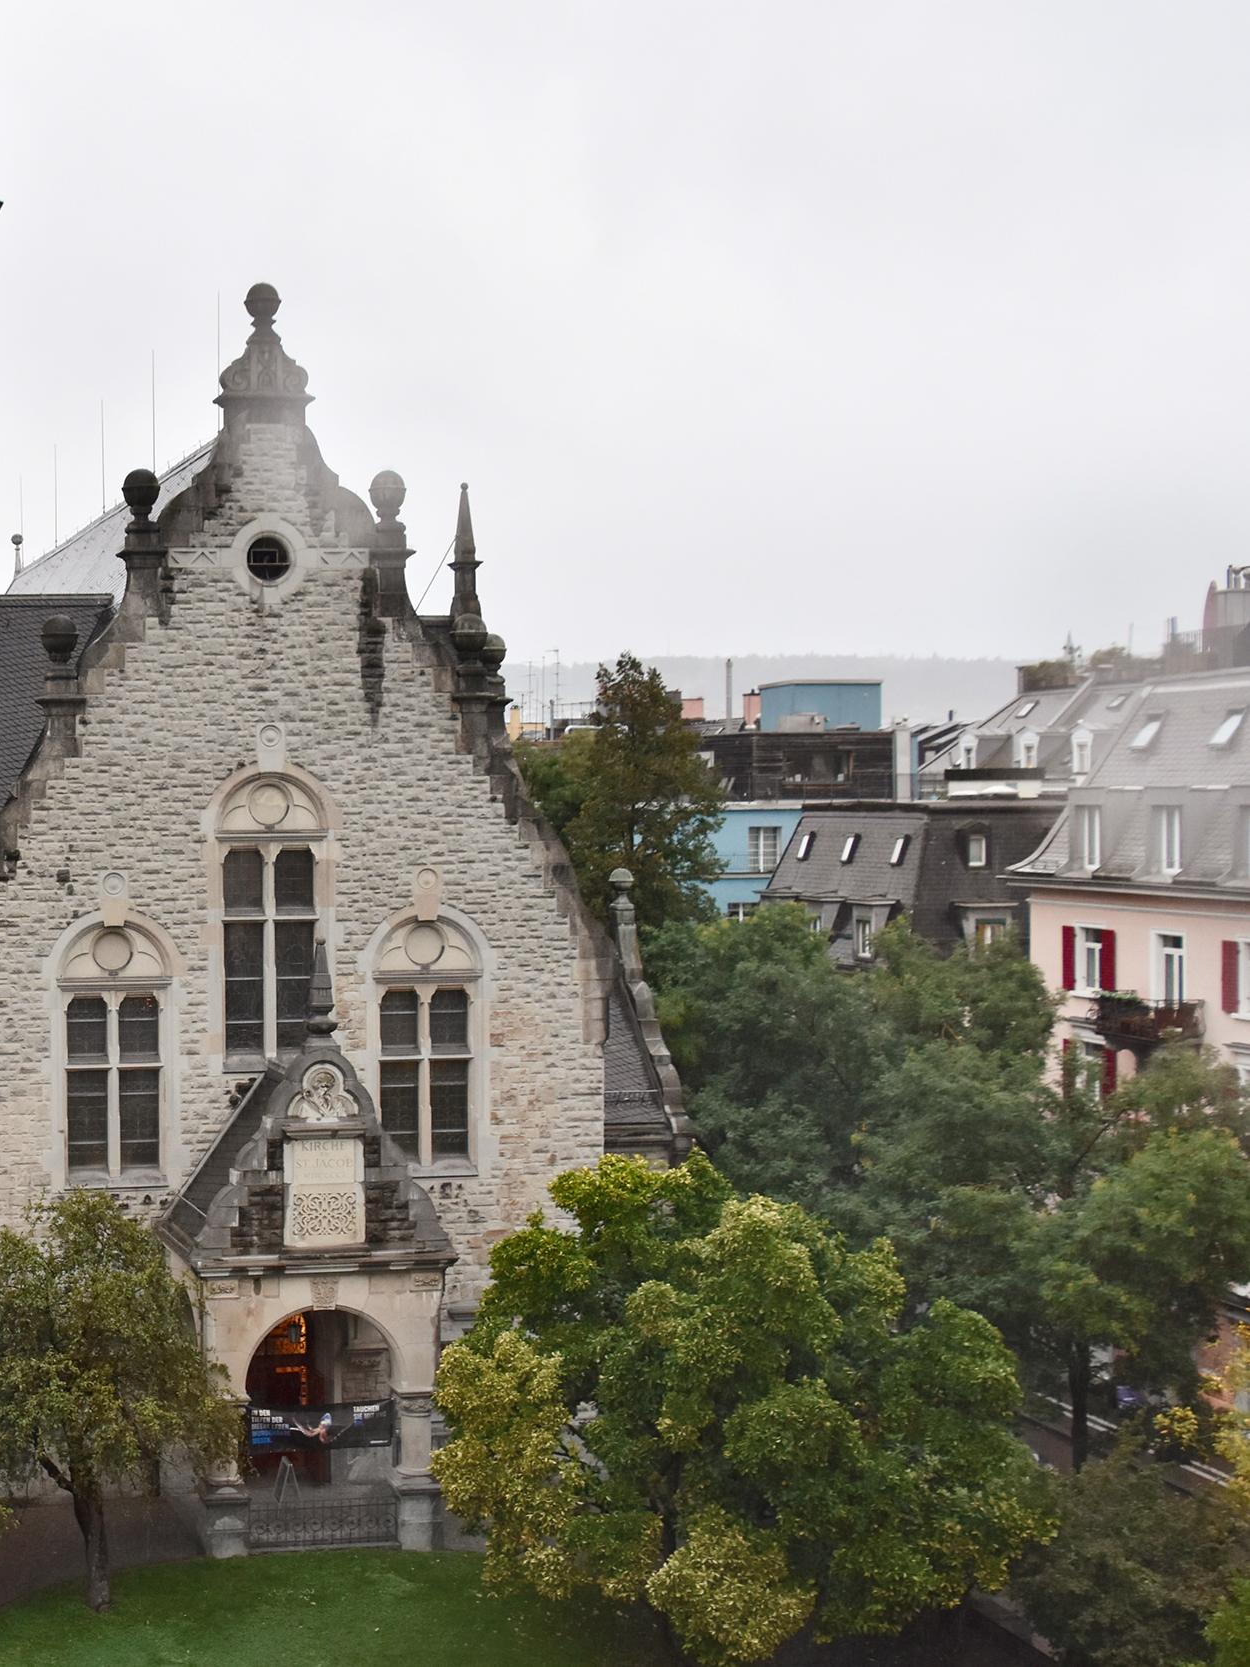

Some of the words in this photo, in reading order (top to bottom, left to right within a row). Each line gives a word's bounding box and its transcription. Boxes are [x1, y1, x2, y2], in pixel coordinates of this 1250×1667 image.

[302, 1141, 346, 1151] KIRCHE
[313, 1158, 353, 1168] JACOB
[259, 1409, 271, 1417] DEN
[353, 1412, 363, 1420] SIE
[271, 1416, 284, 1424] DER
